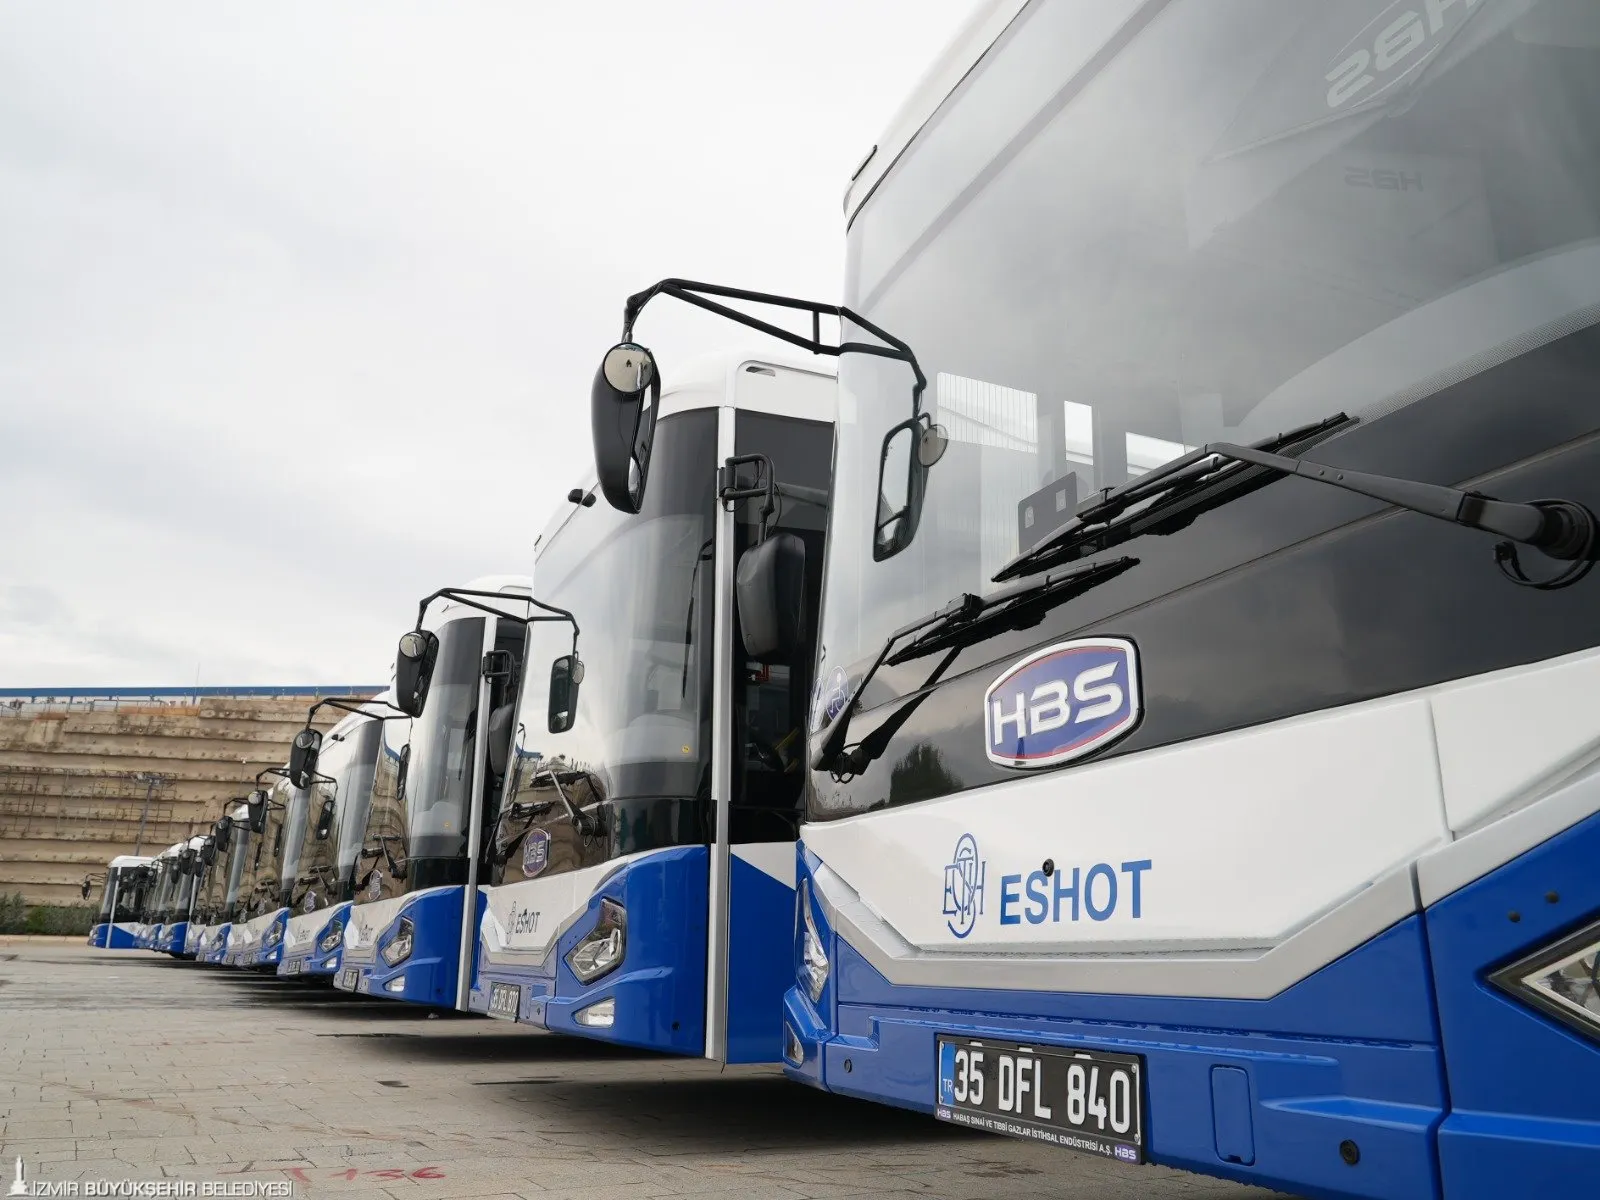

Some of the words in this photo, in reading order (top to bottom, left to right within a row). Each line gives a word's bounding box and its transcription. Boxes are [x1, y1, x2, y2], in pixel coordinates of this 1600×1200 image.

[993, 661, 1123, 746] HBS
[1000, 859, 1152, 925] ESHOT
[943, 1078, 953, 1093] TR
[955, 1049, 984, 1105] 35
[998, 1055, 1051, 1119] DFL
[1067, 1064, 1130, 1134] 840
[953, 1113, 971, 1125] HABAŞ
[986, 1119, 993, 1129] VE
[1008, 1125, 1031, 1137] GAZLAR
[1031, 1127, 1060, 1143] İSTİHSAL
[1059, 1134, 1099, 1151] ENDÜSTRİSİ
[1099, 1143, 1113, 1156] A.Ş.
